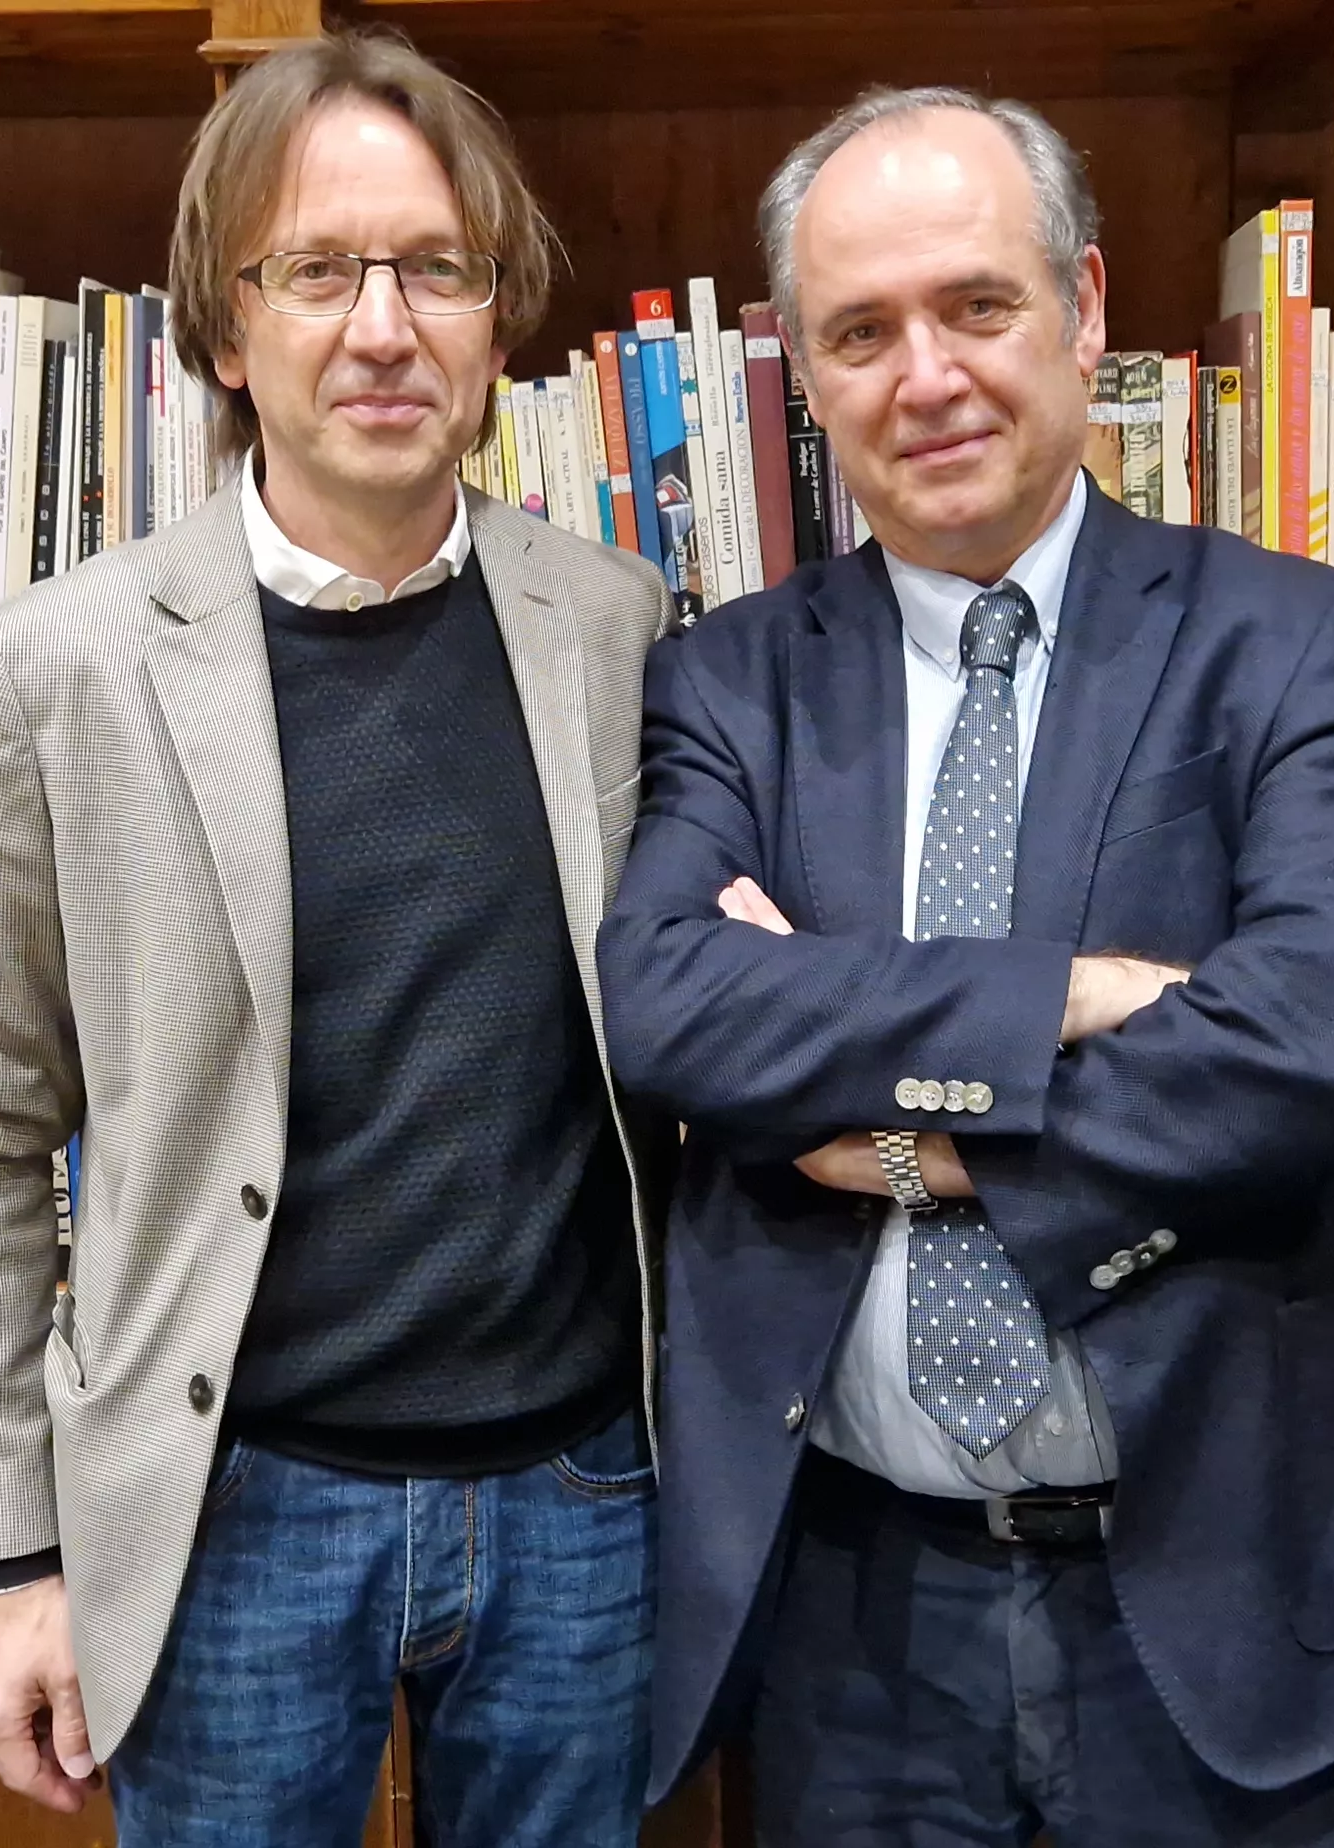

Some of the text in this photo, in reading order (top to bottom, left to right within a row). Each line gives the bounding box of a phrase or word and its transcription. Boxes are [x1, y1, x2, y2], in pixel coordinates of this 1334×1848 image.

[650, 300, 662, 316] 6
[714, 451, 735, 565] Comida sana
